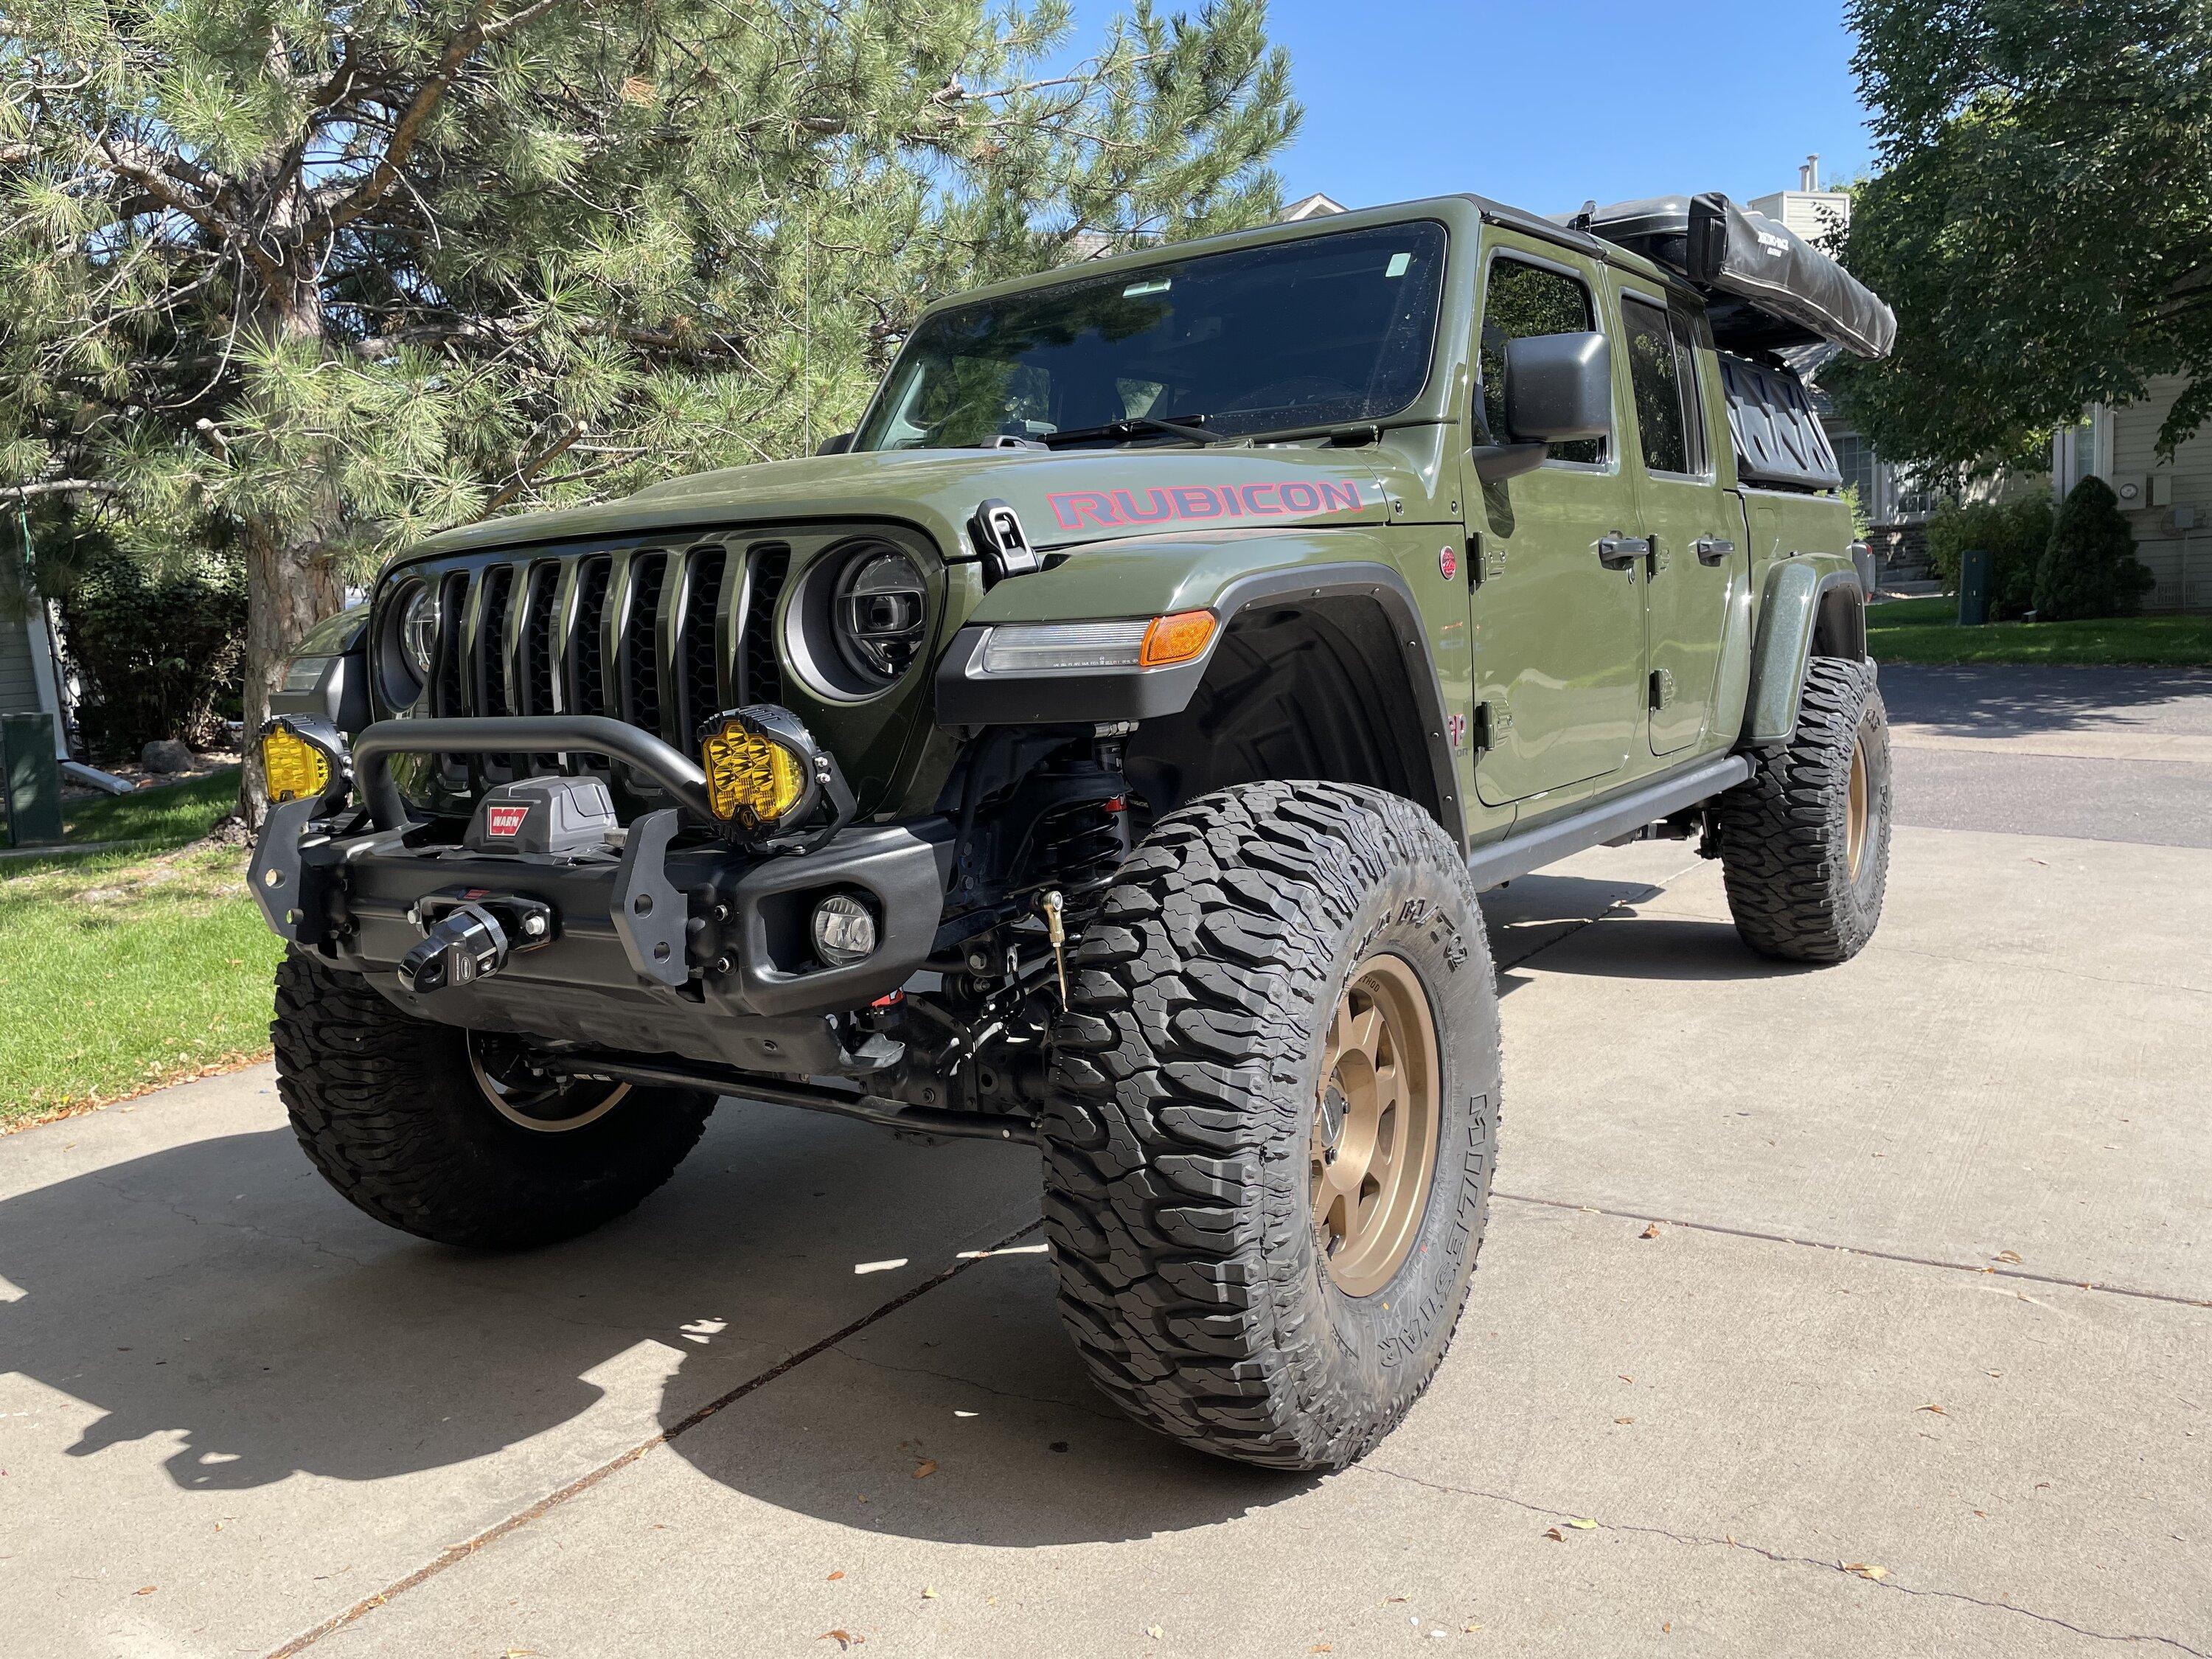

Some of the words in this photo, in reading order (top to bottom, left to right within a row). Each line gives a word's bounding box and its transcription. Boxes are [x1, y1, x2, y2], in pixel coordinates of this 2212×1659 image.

[1046, 481, 1363, 529] RUBICON
[493, 815, 519, 827] WARN
[1358, 975, 1380, 992] THOD
[1377, 1093, 1488, 1368] MILESTAR
